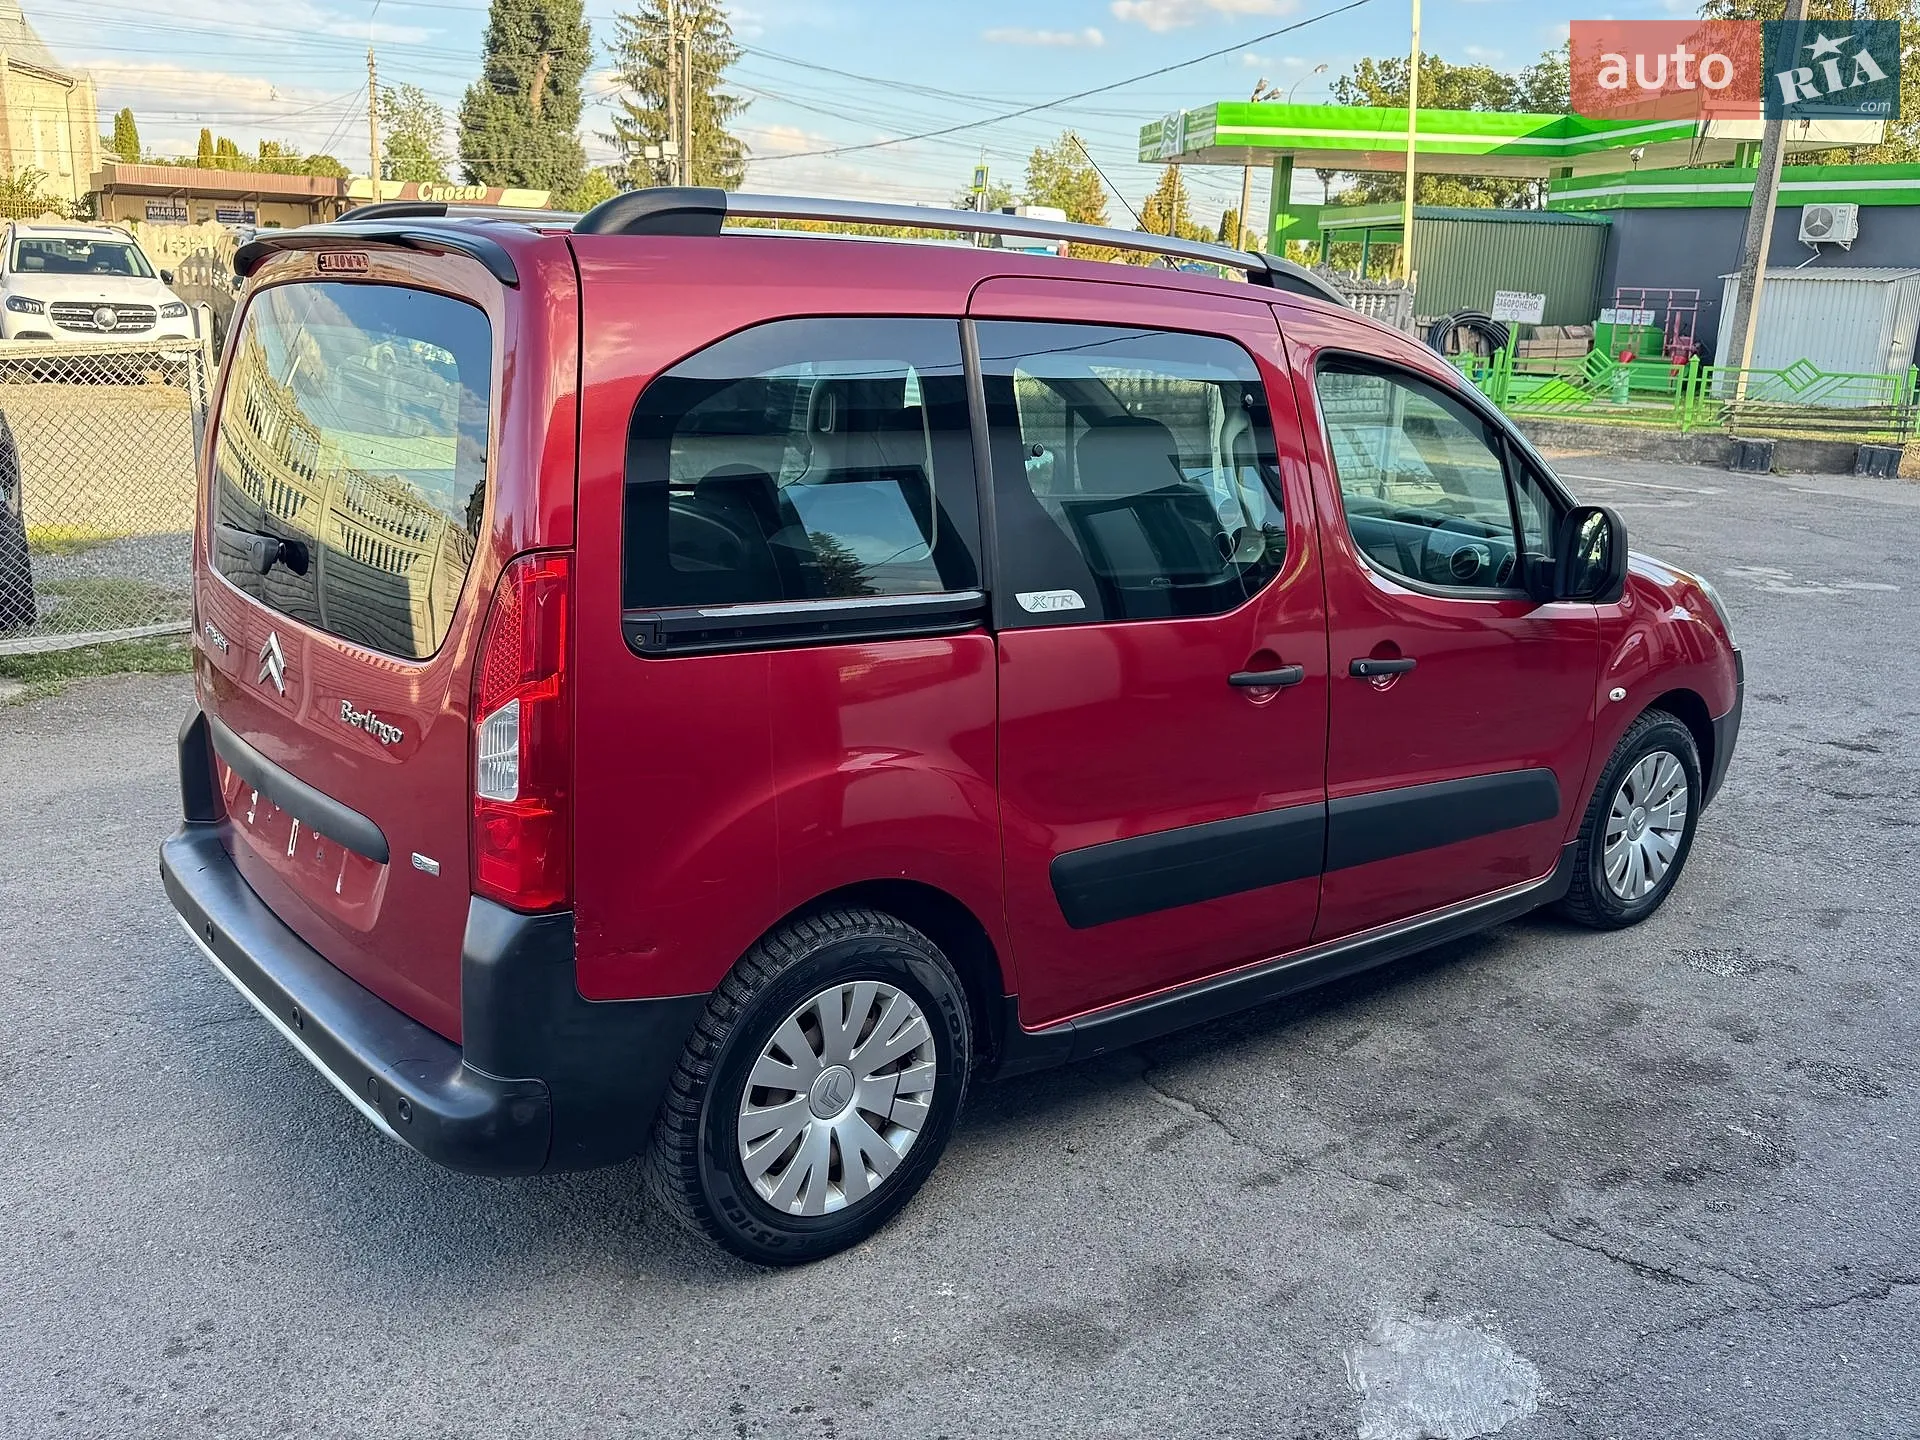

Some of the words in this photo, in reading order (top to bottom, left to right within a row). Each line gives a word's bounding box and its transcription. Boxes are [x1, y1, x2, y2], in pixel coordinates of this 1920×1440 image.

[417, 180, 488, 202] Спогад
[148, 207, 186, 217] АНАЛІЗИ
[1030, 594, 1074, 610] XTR
[340, 699, 404, 745] Berlingo
[940, 992, 963, 1078] TOYO
